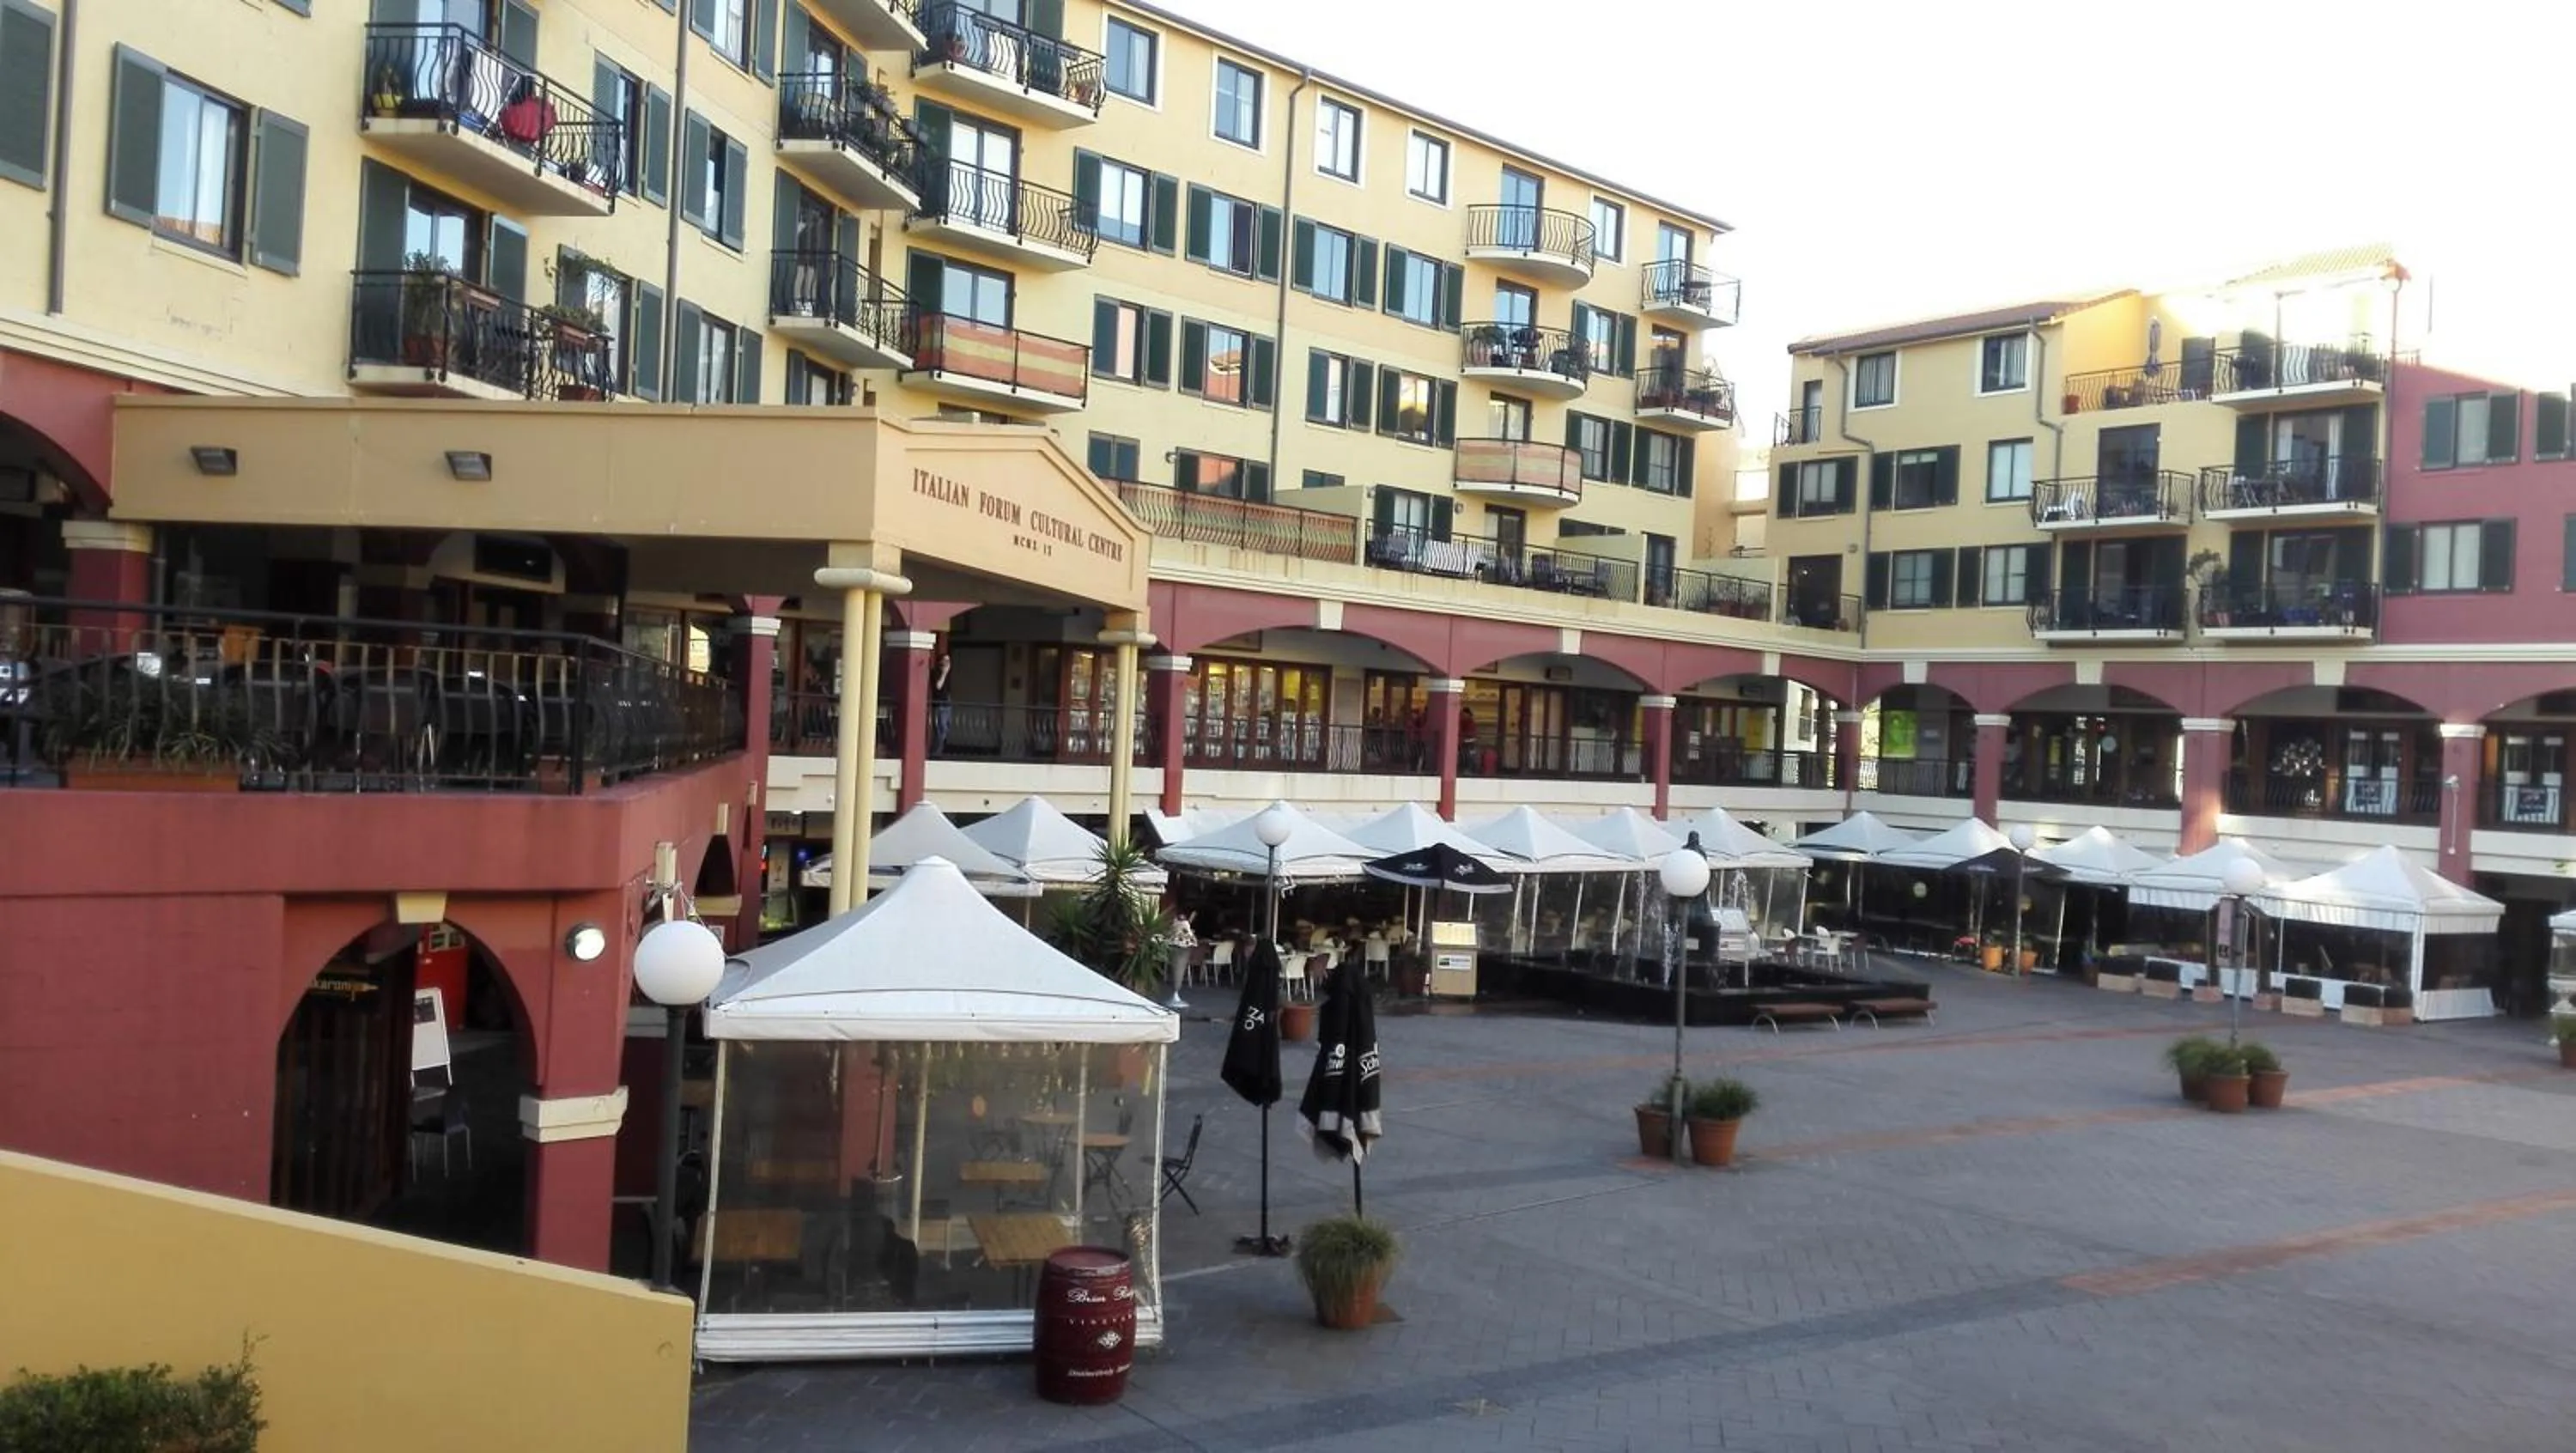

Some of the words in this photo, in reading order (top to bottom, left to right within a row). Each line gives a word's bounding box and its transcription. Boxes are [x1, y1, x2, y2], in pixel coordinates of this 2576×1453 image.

[913, 468, 969, 508] ITALIAN
[979, 491, 1022, 526] FORUM
[1030, 510, 1084, 548] CULTURAL
[1088, 532, 1123, 562] CENTRE
